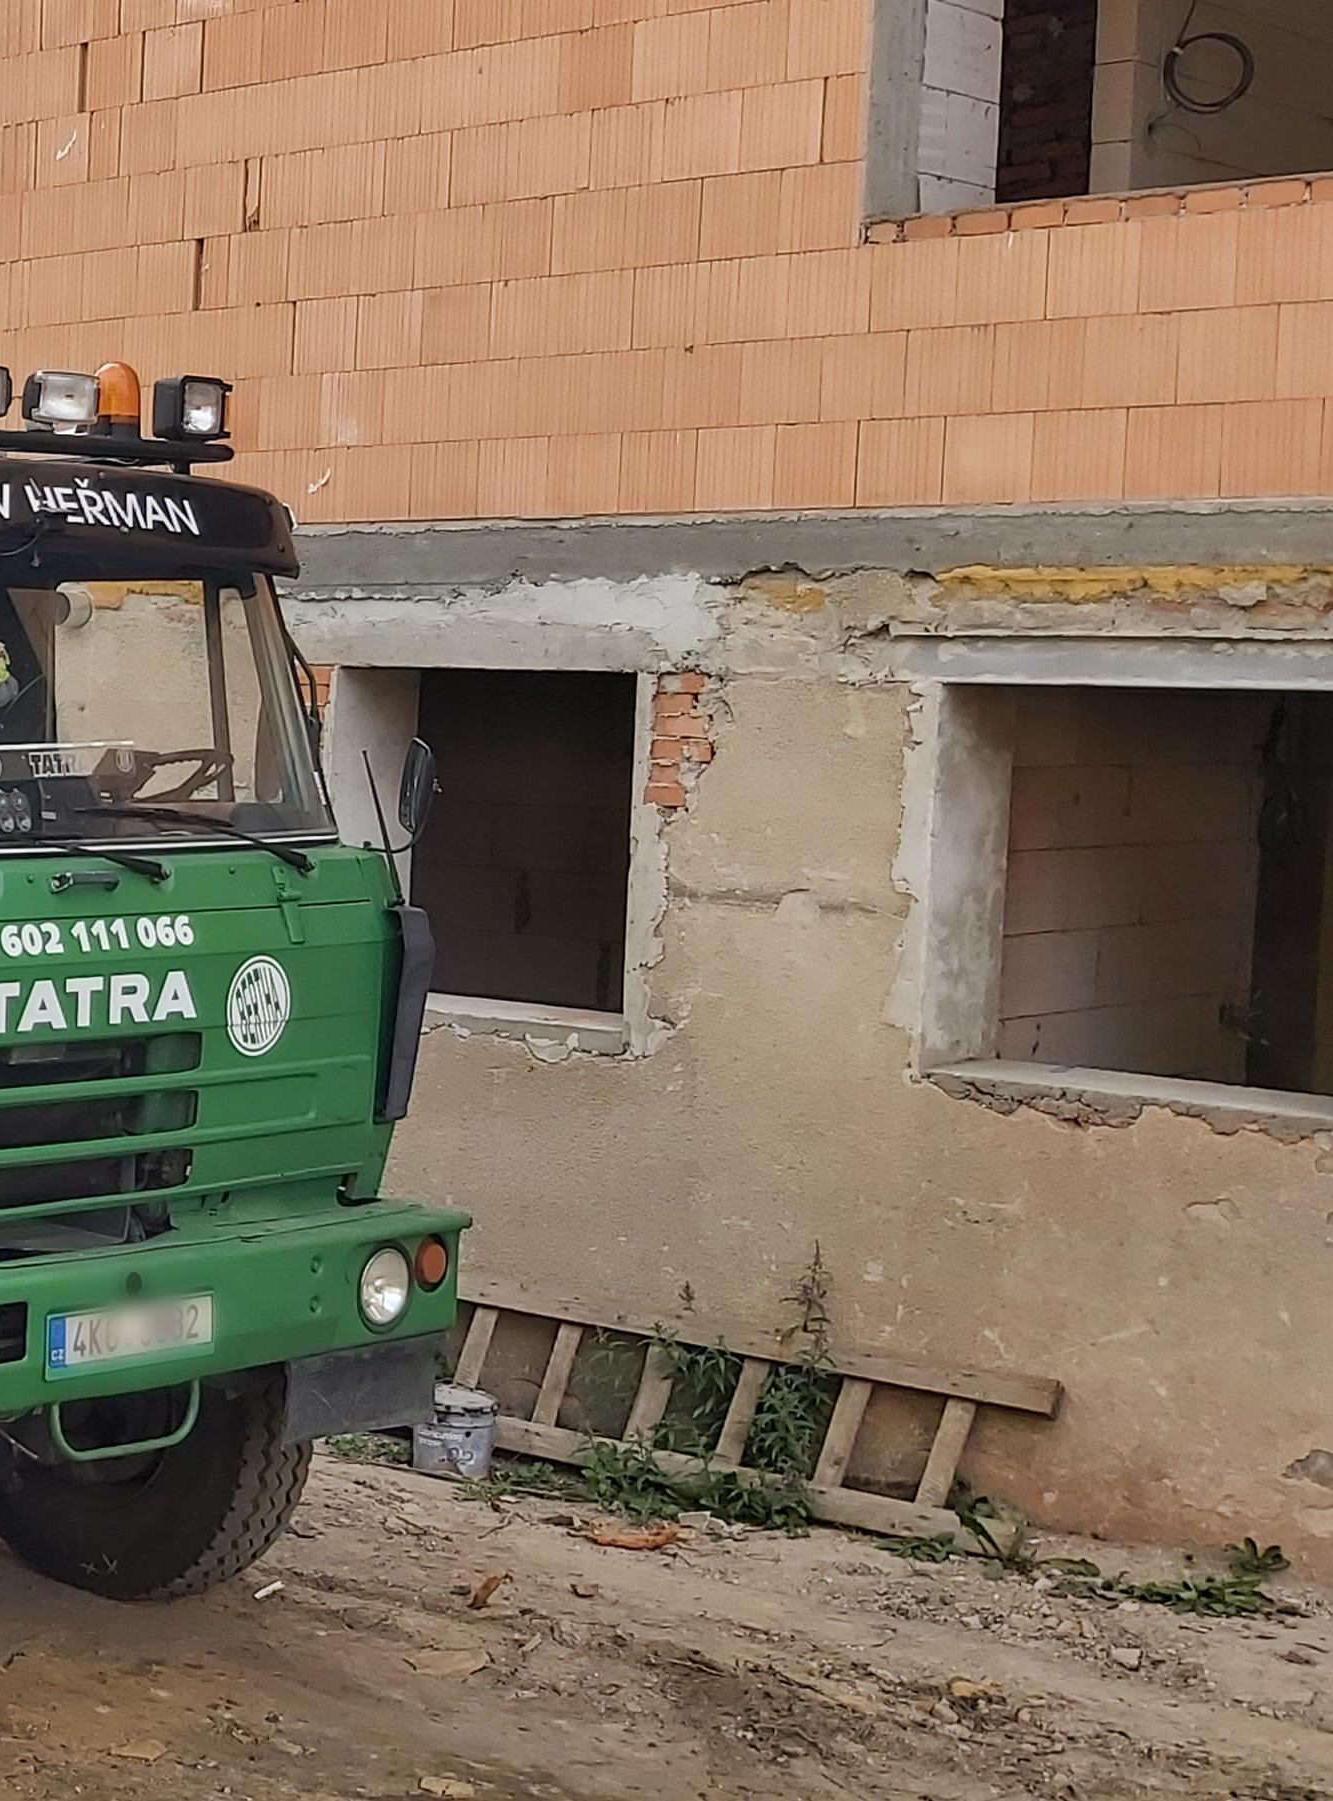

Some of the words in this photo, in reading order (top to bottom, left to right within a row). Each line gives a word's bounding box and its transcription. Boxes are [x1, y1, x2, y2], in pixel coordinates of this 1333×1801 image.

[24, 477, 202, 536] HEŘMAN
[29, 753, 92, 777] TATR
[0, 922, 65, 957] 602
[70, 918, 130, 952] 111
[136, 915, 194, 948] 066
[50, 1348, 66, 1362] CZ
